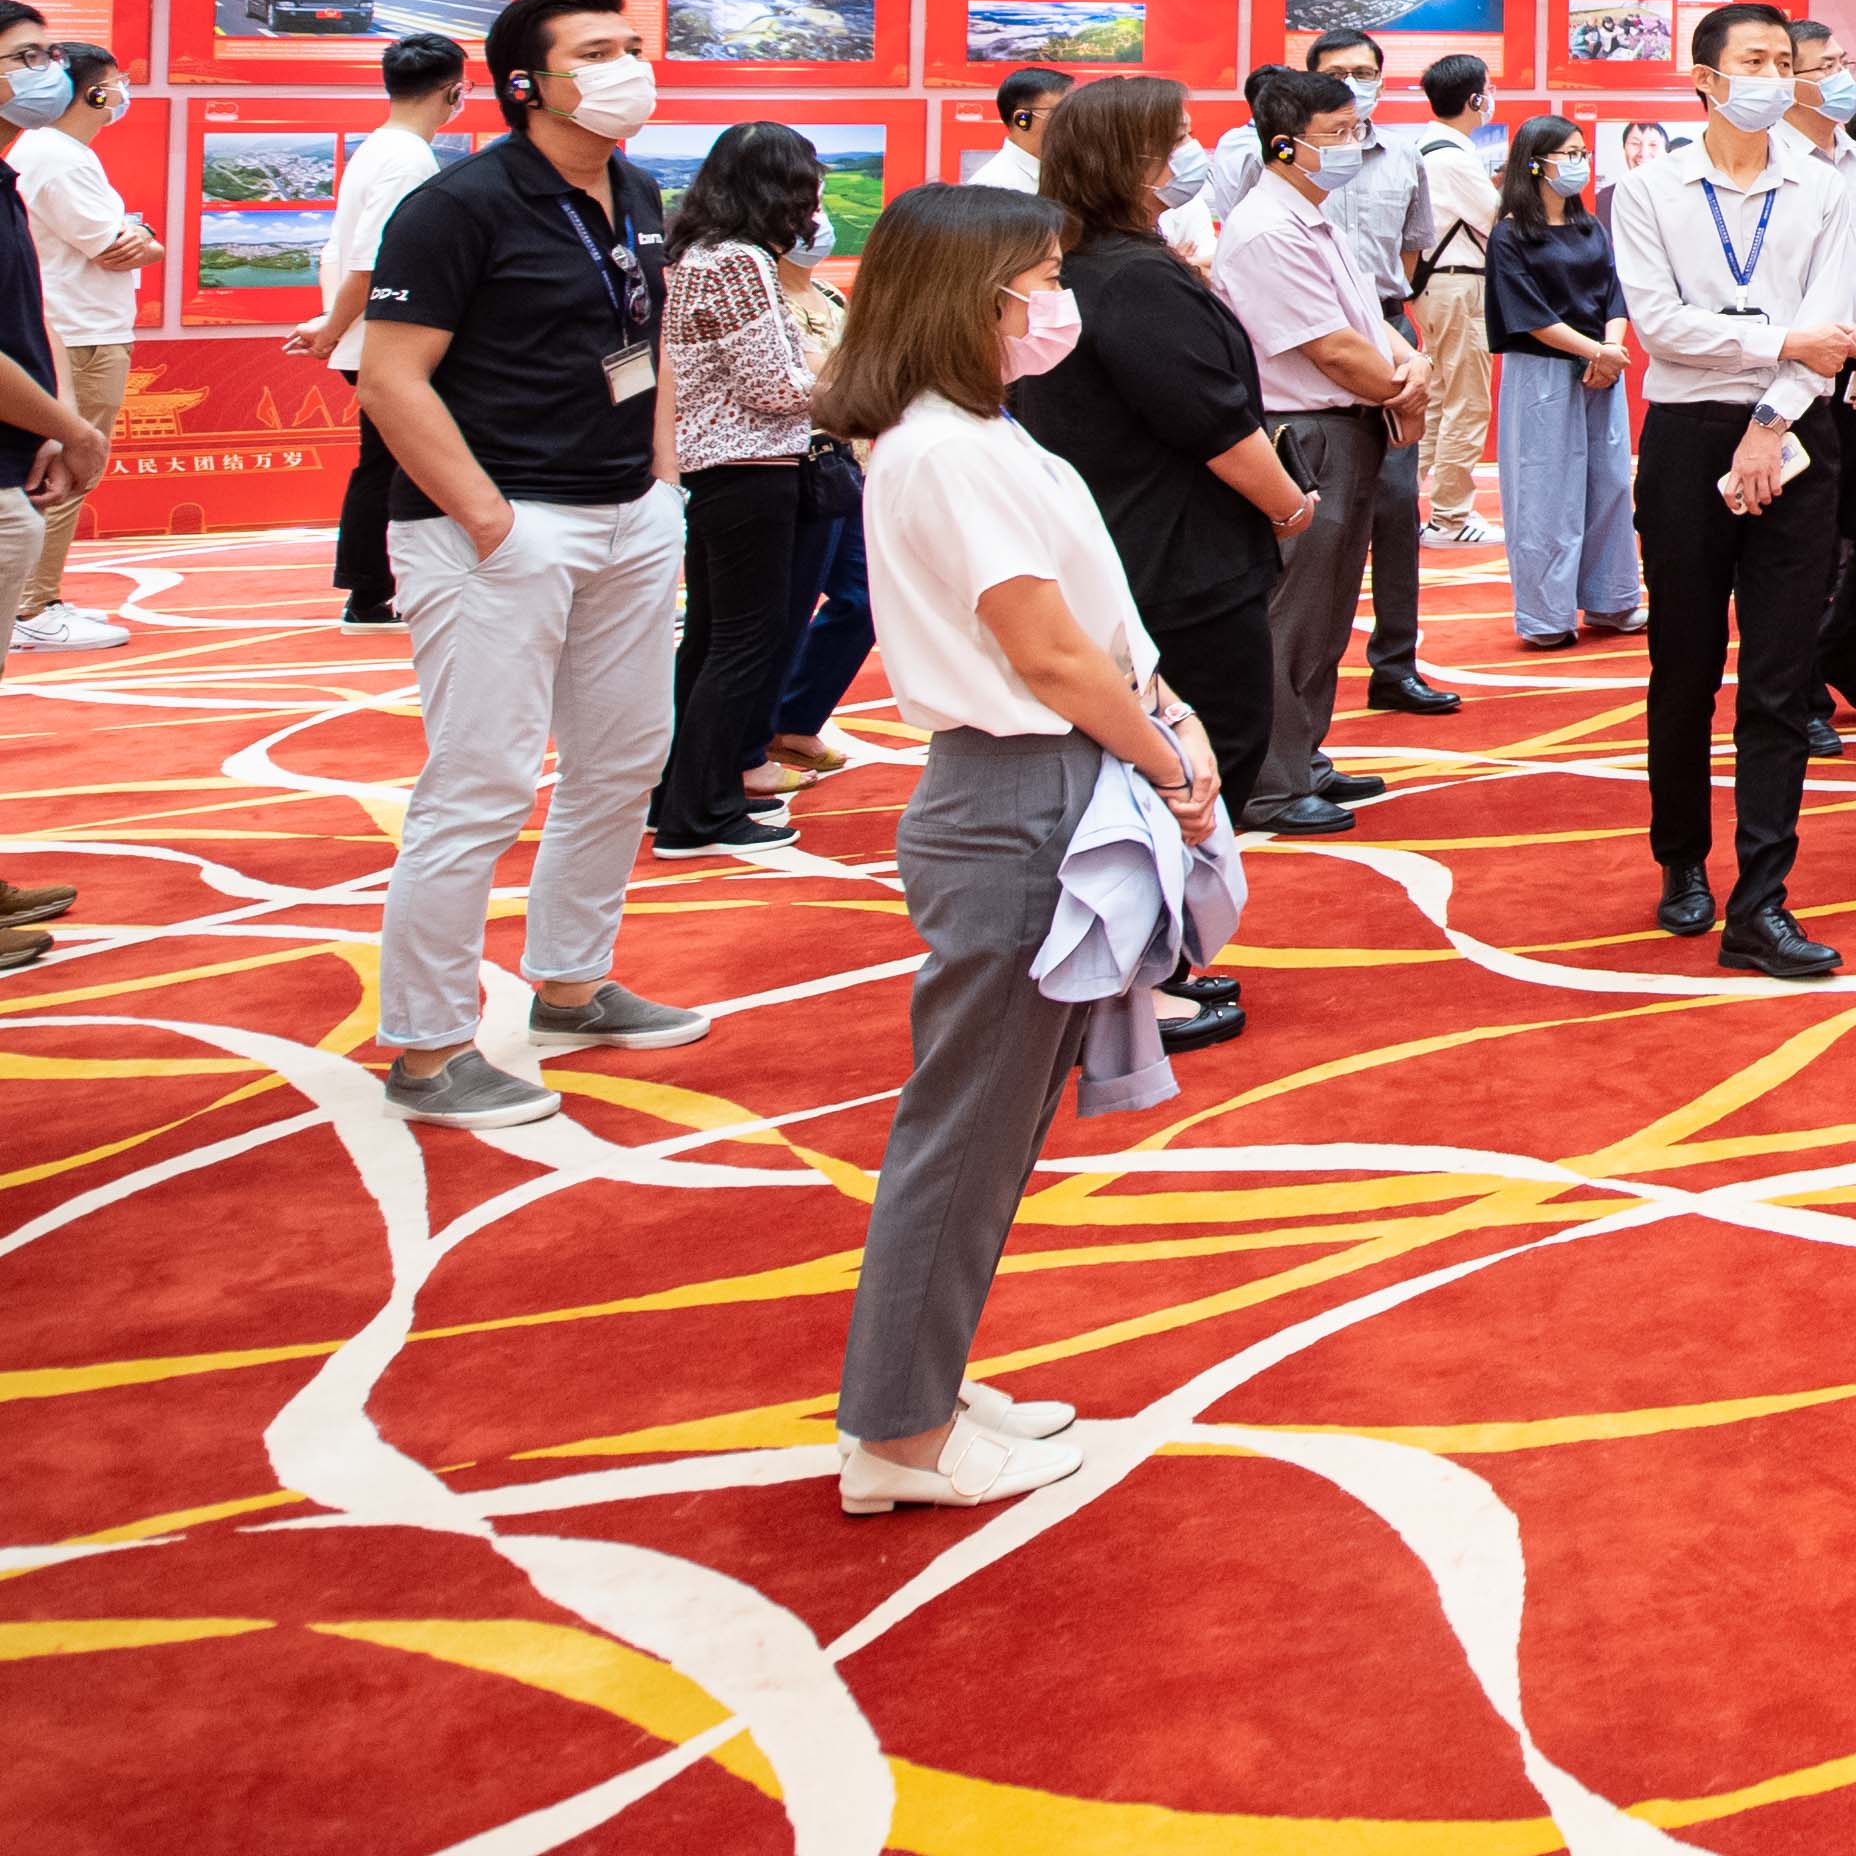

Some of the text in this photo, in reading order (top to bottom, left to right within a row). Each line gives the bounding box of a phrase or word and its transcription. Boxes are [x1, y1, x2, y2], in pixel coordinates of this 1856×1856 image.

[111, 451, 303, 475] 人民大团结万岁
